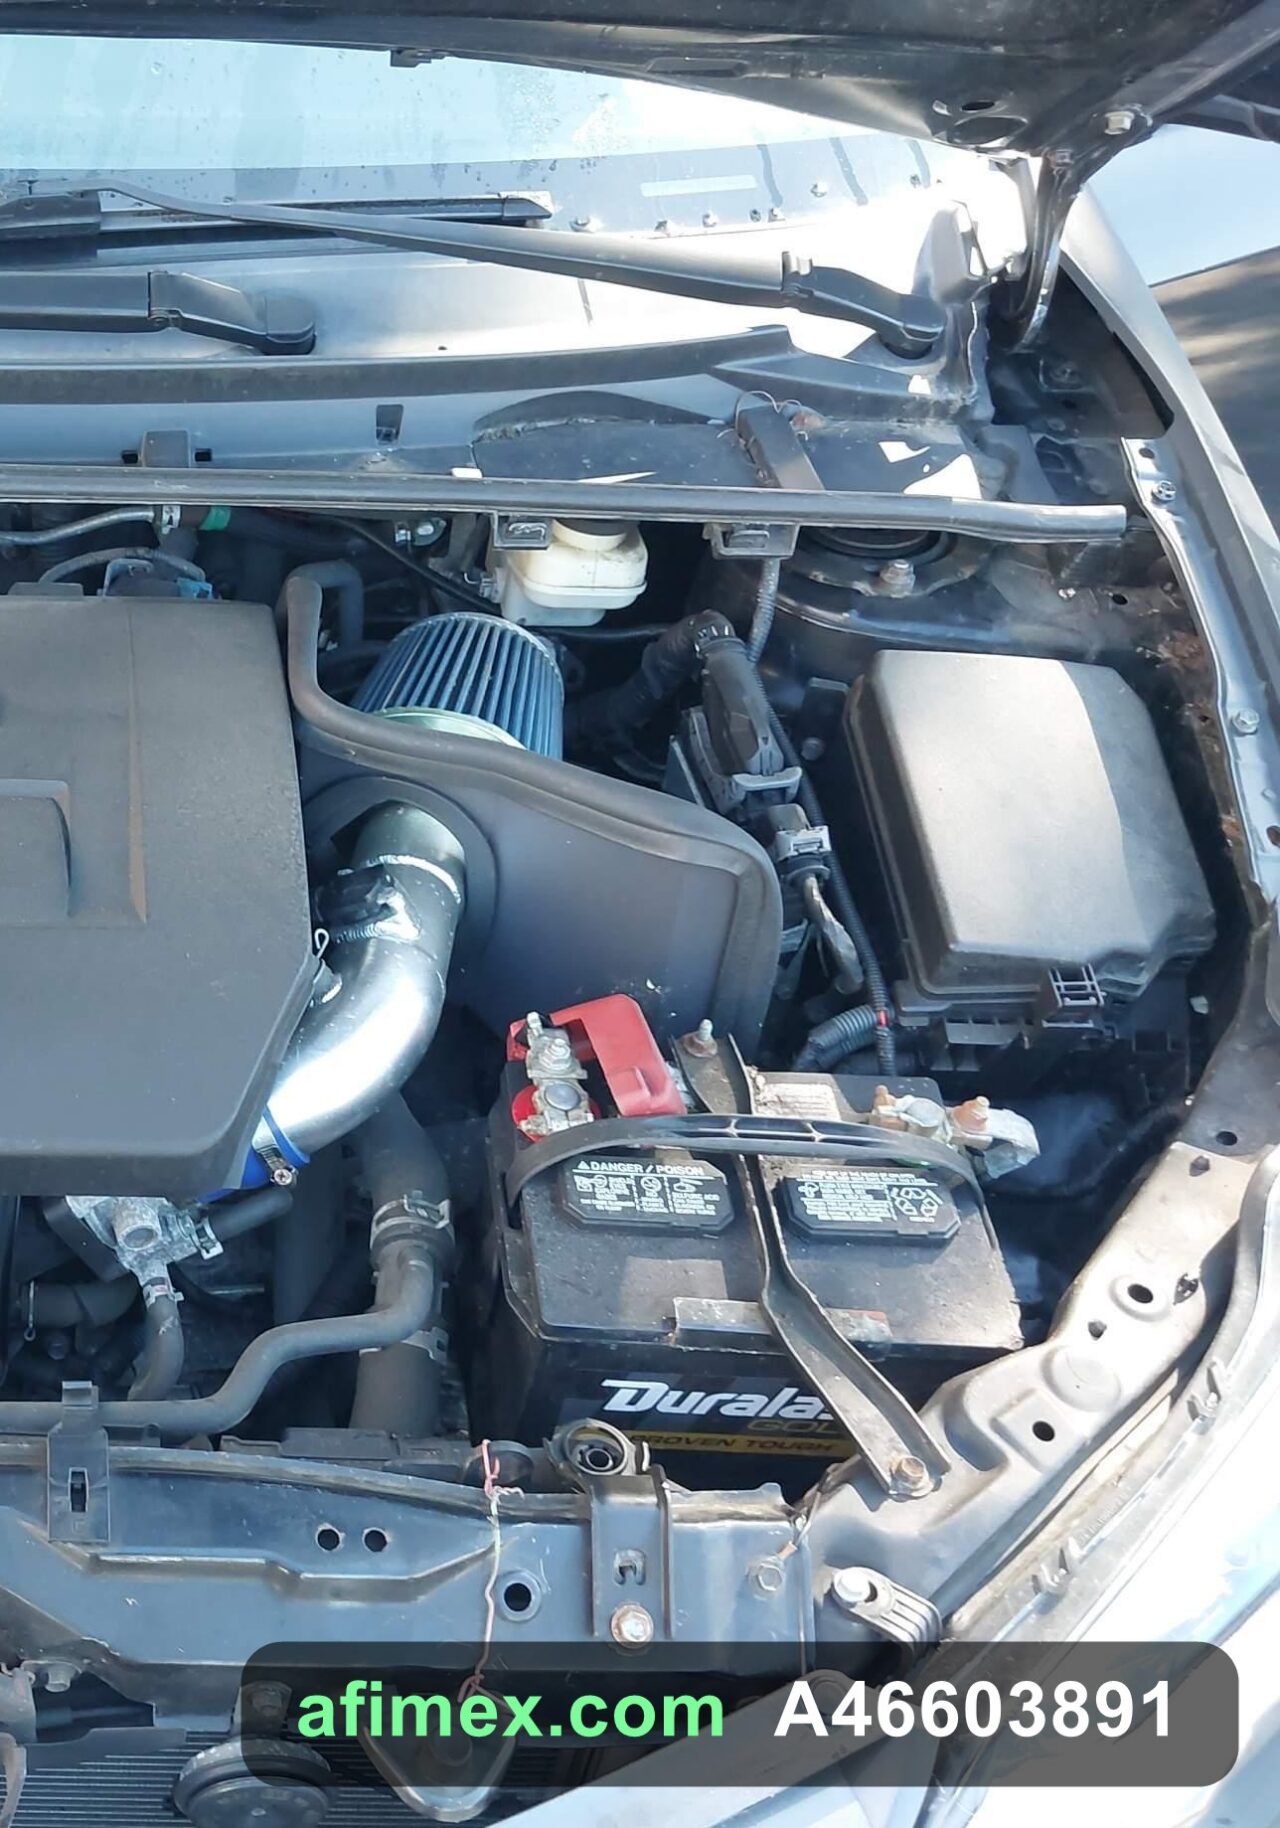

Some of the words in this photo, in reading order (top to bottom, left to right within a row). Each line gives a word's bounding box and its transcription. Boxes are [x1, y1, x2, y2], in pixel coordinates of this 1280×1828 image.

[590, 1160, 644, 1173] DANGER
[655, 1164, 705, 1176] POISON
[747, 1420, 839, 1434] GOL
[746, 1439, 834, 1452] TOUGH
